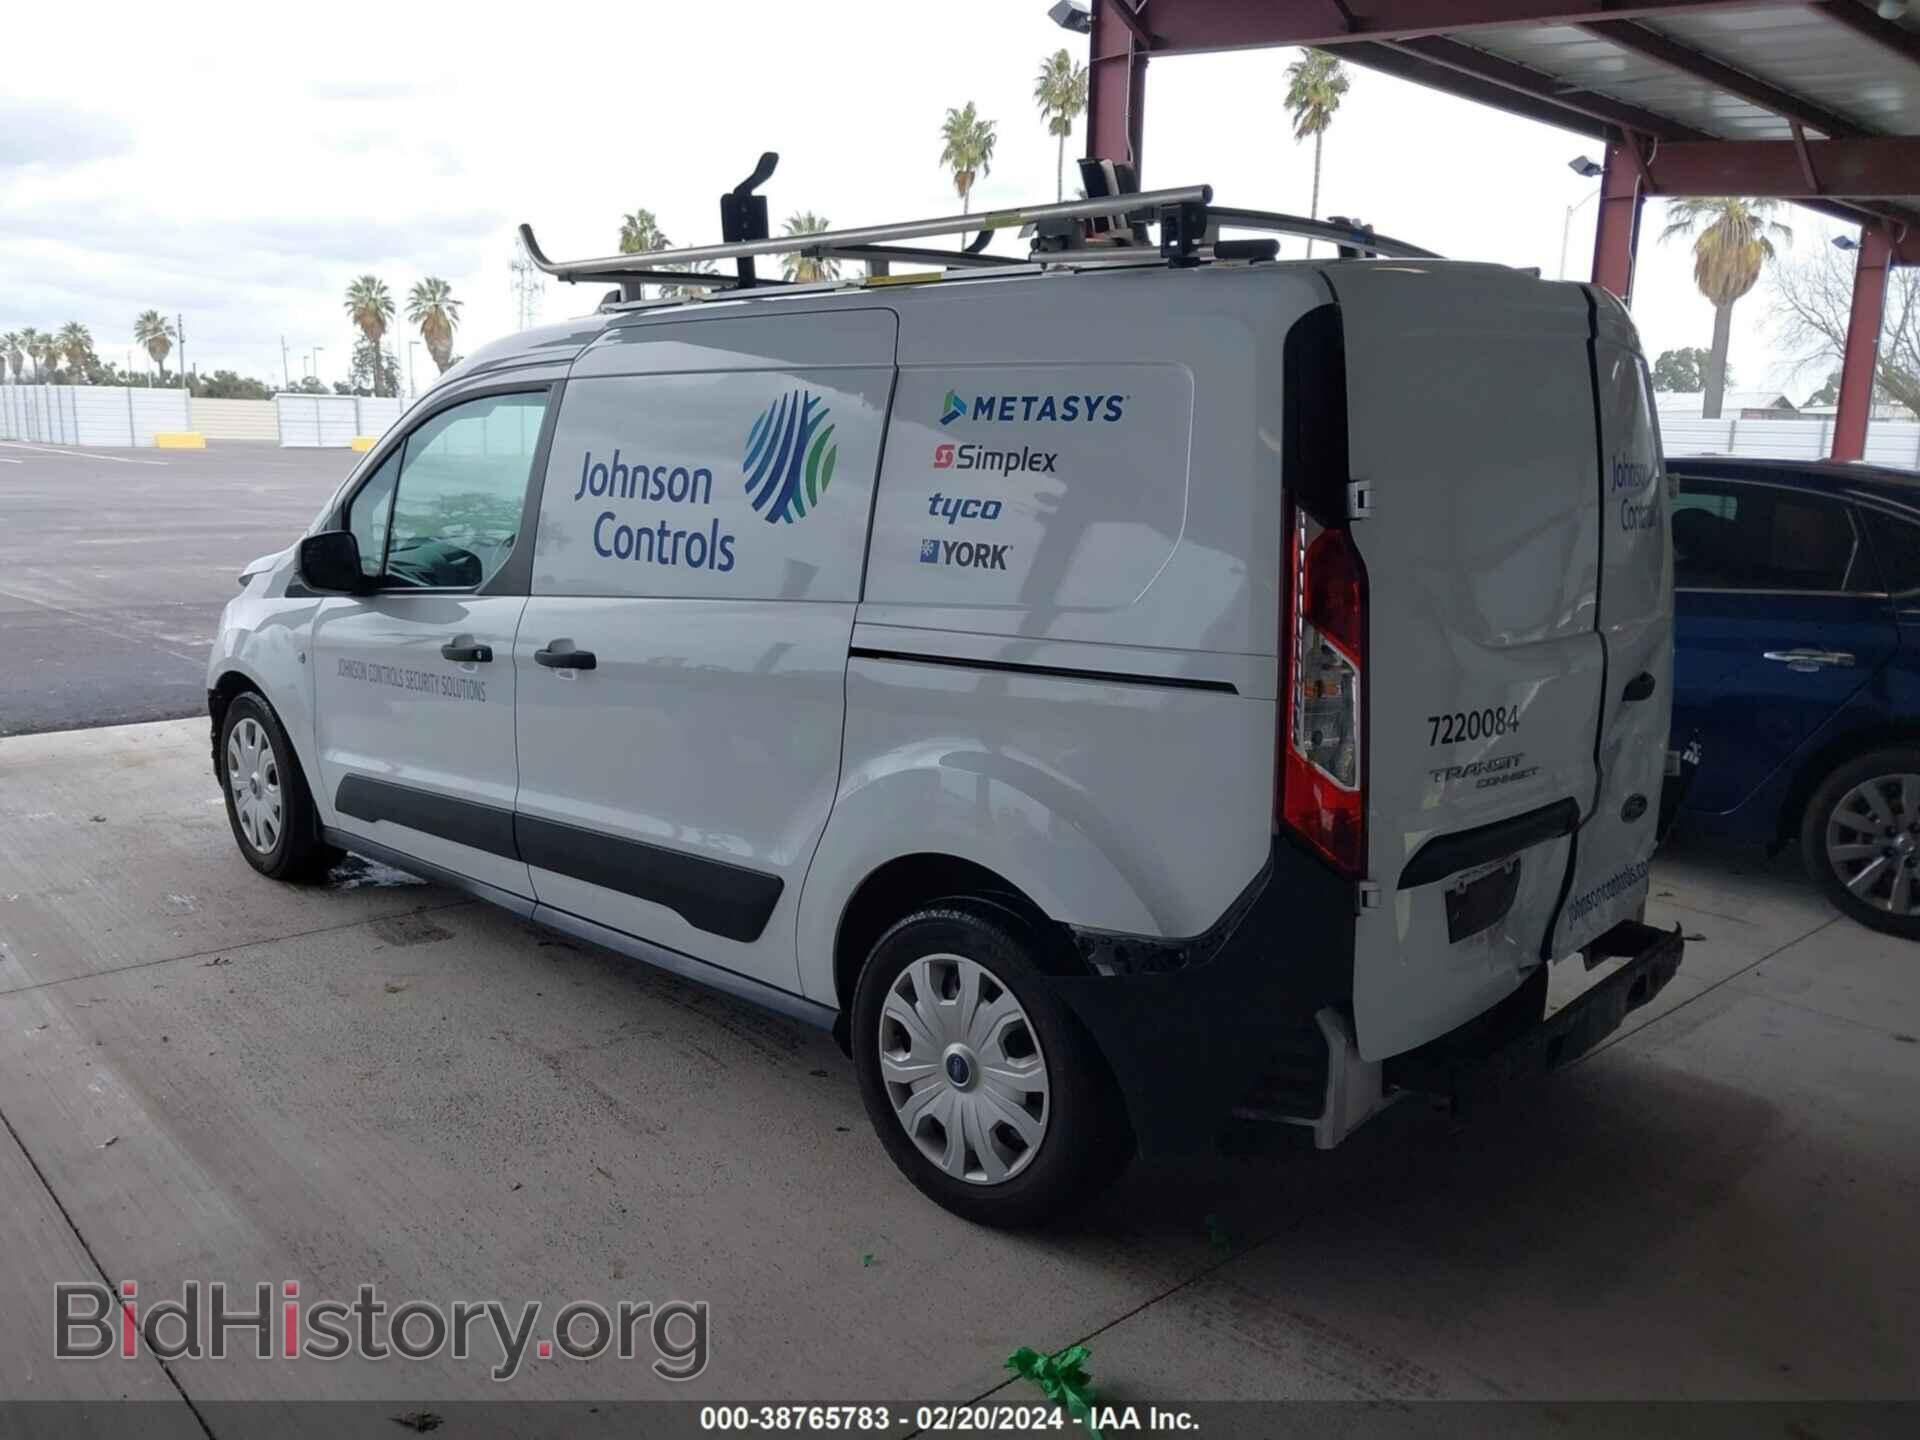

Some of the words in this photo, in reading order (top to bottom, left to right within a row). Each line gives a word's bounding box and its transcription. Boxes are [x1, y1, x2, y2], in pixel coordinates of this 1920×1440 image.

[972, 395, 1124, 422] METASYS
[574, 448, 713, 504] Johnson
[956, 444, 1058, 477] Simplex
[928, 492, 1002, 525] tyco
[593, 511, 736, 572] Controls
[942, 541, 1009, 570] YORK
[367, 663, 404, 688] CONTROLS
[405, 669, 440, 695] SECURITY
[441, 675, 486, 702] SOLUTIONS
[1427, 704, 1520, 747] 7220084
[1428, 751, 1526, 783] TRANSIT
